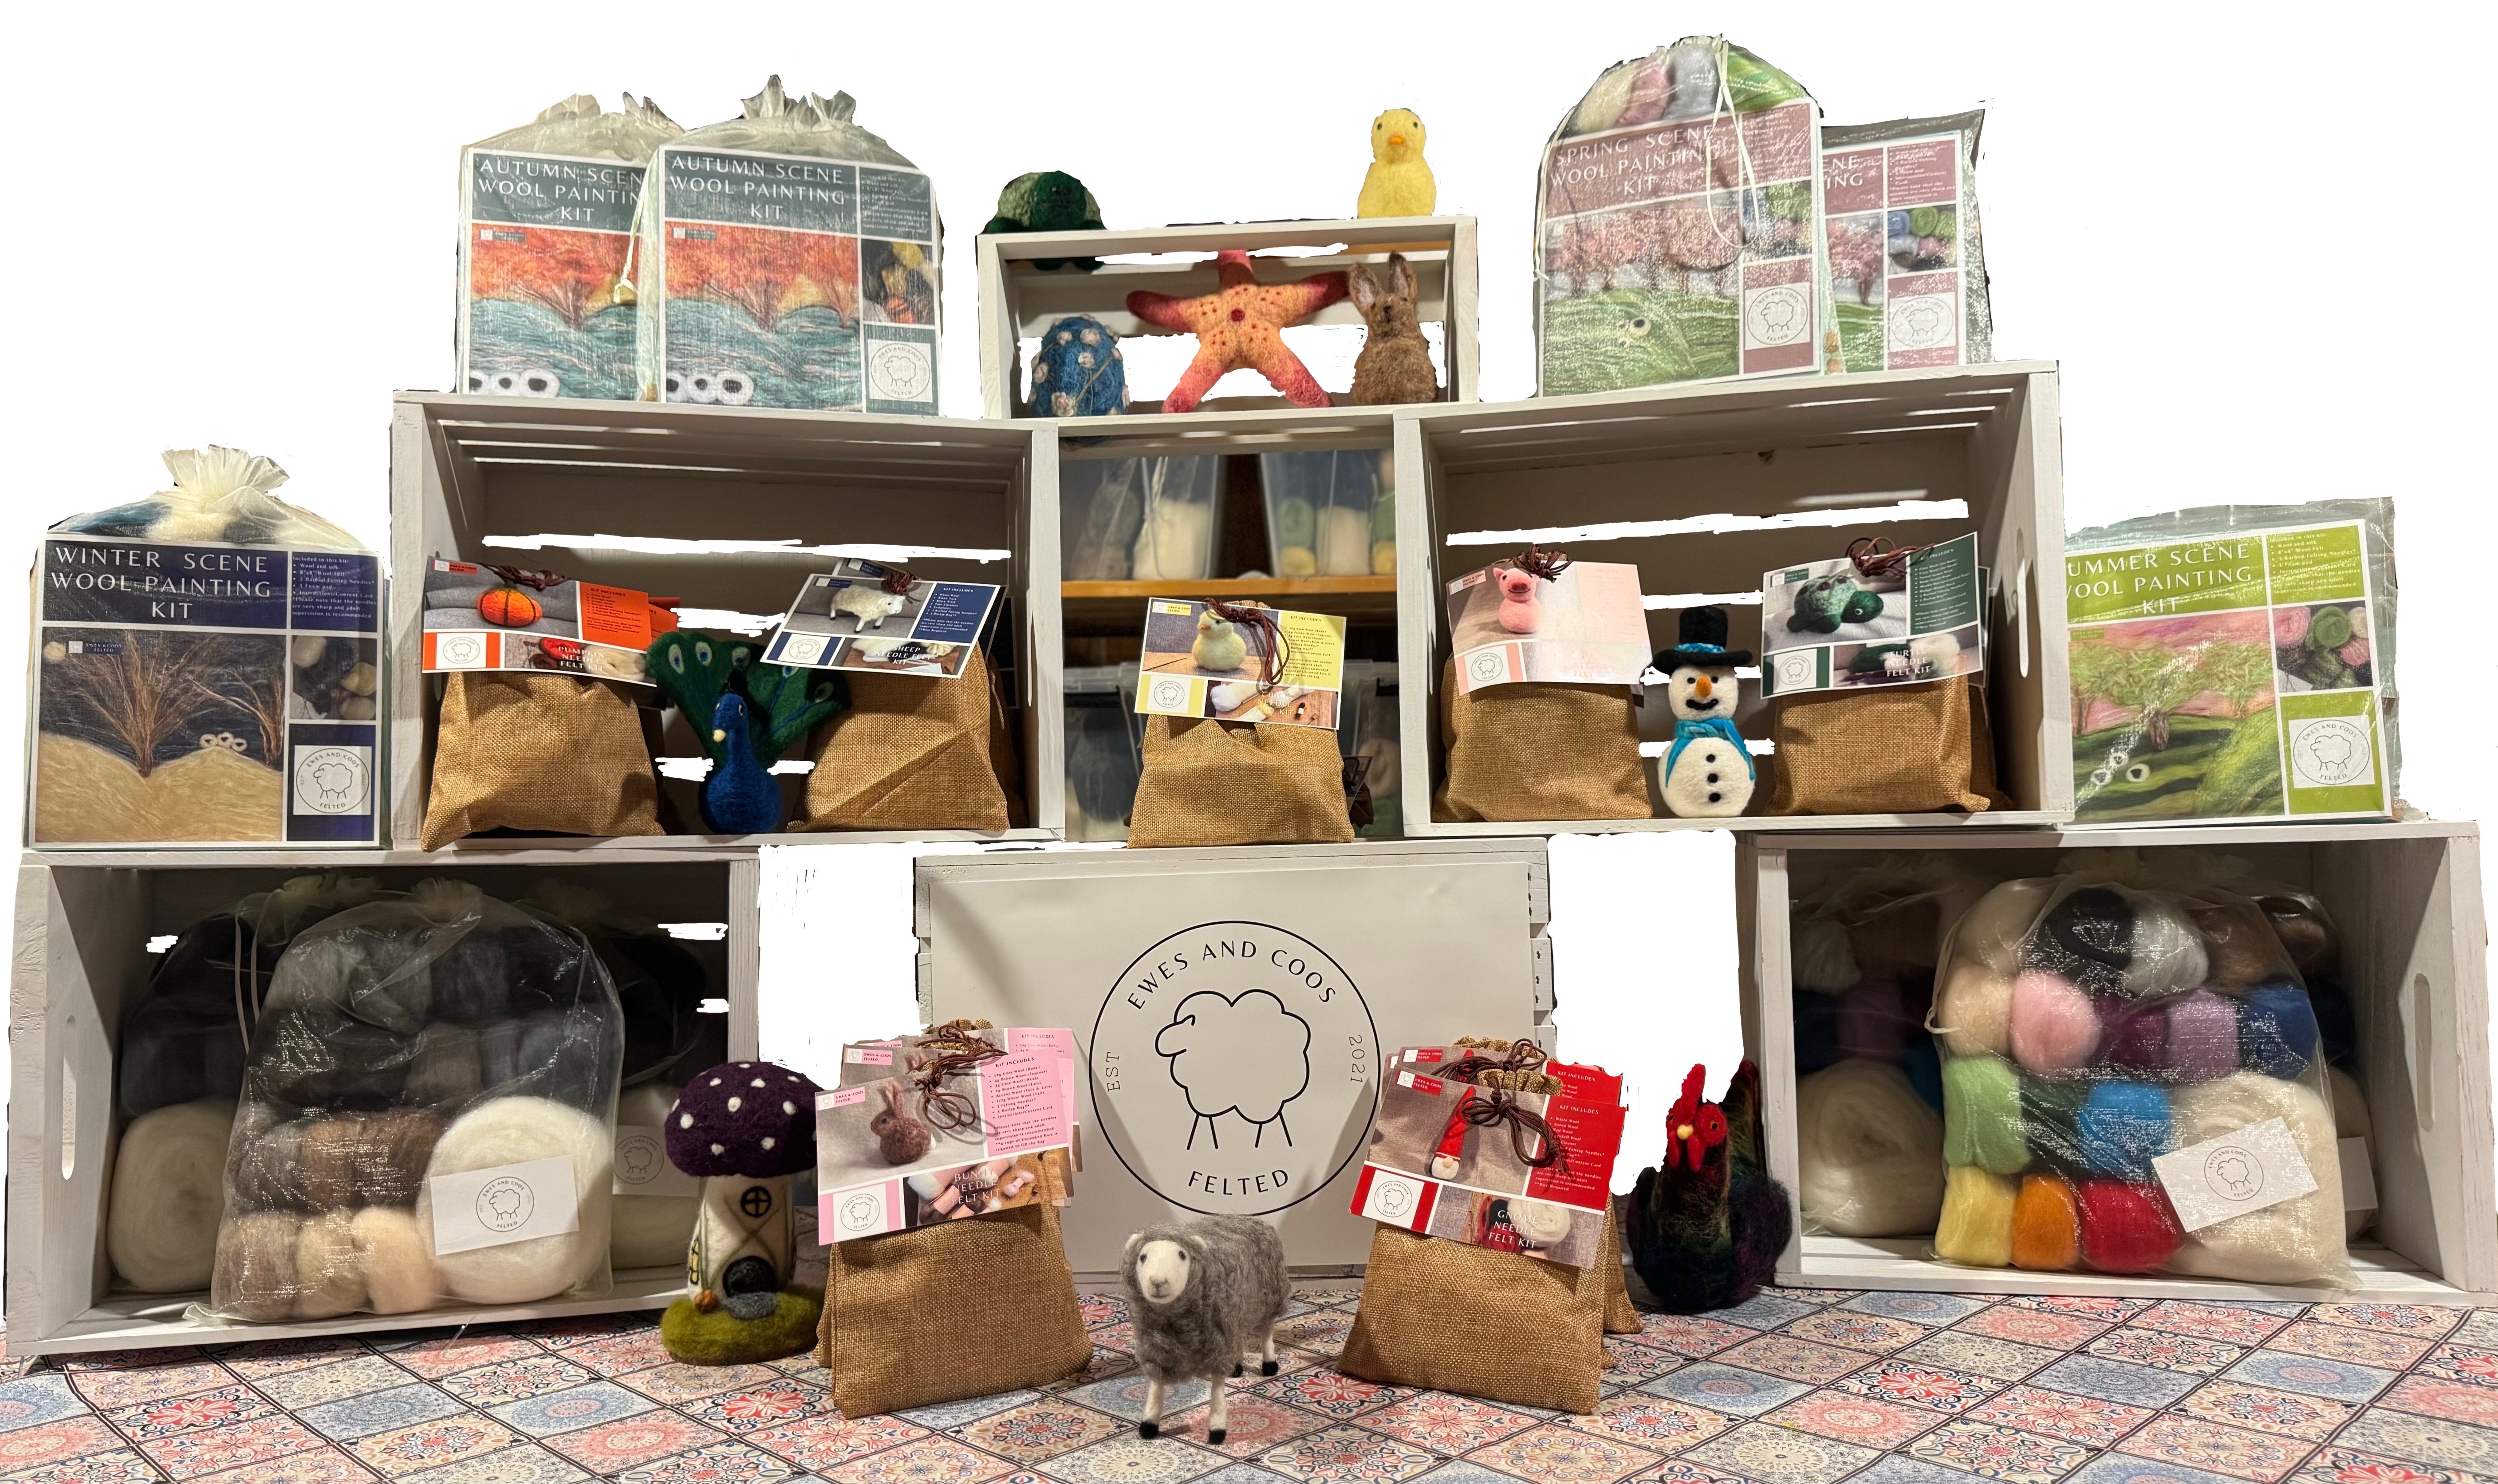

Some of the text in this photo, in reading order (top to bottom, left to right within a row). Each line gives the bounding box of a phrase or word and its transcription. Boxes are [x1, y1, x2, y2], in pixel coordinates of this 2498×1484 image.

[1556, 138, 1628, 165] SPRING
[480, 159, 642, 185] AUTUMN SCEN
[672, 156, 843, 184] AUTUMN SCENE
[1551, 163, 1608, 188] WOOL
[479, 179, 640, 205] WOOL PAINTIN
[670, 176, 844, 205] WOOL PAINTING
[1624, 176, 1656, 195] KIT
[561, 206, 594, 221] KIT
[751, 203, 783, 220] KIT
[55, 547, 268, 572] WINTER SCENE
[2068, 543, 2249, 577] UMMER SCENE
[51, 572, 270, 598] WOOL PAINTING
[2135, 566, 2251, 592] PAINTING
[153, 602, 193, 618] KIT
[2143, 598, 2180, 615] KIT
[559, 646, 604, 658] PUMPKIN
[1887, 668, 1911, 677] FELT
[2303, 728, 2318, 740] EWES
[2340, 725, 2357, 737] COOS
[307, 755, 323, 767] EWES
[343, 755, 359, 768] COOS
[1127, 940, 1336, 1010] EWES AND COOS
[1348, 1034, 1365, 1084] 2021
[1105, 1051, 1121, 1092] EST
[483, 1185, 495, 1197] EWES
[511, 1181, 524, 1190] COOS
[1188, 1169, 1288, 1195] FELTED
[952, 1189, 1000, 1205] FELT KIT
[1498, 1210, 1538, 1224] GNOME
[1494, 1221, 1536, 1236] NEEDLE
[1489, 1232, 1537, 1248] FELT KIT
